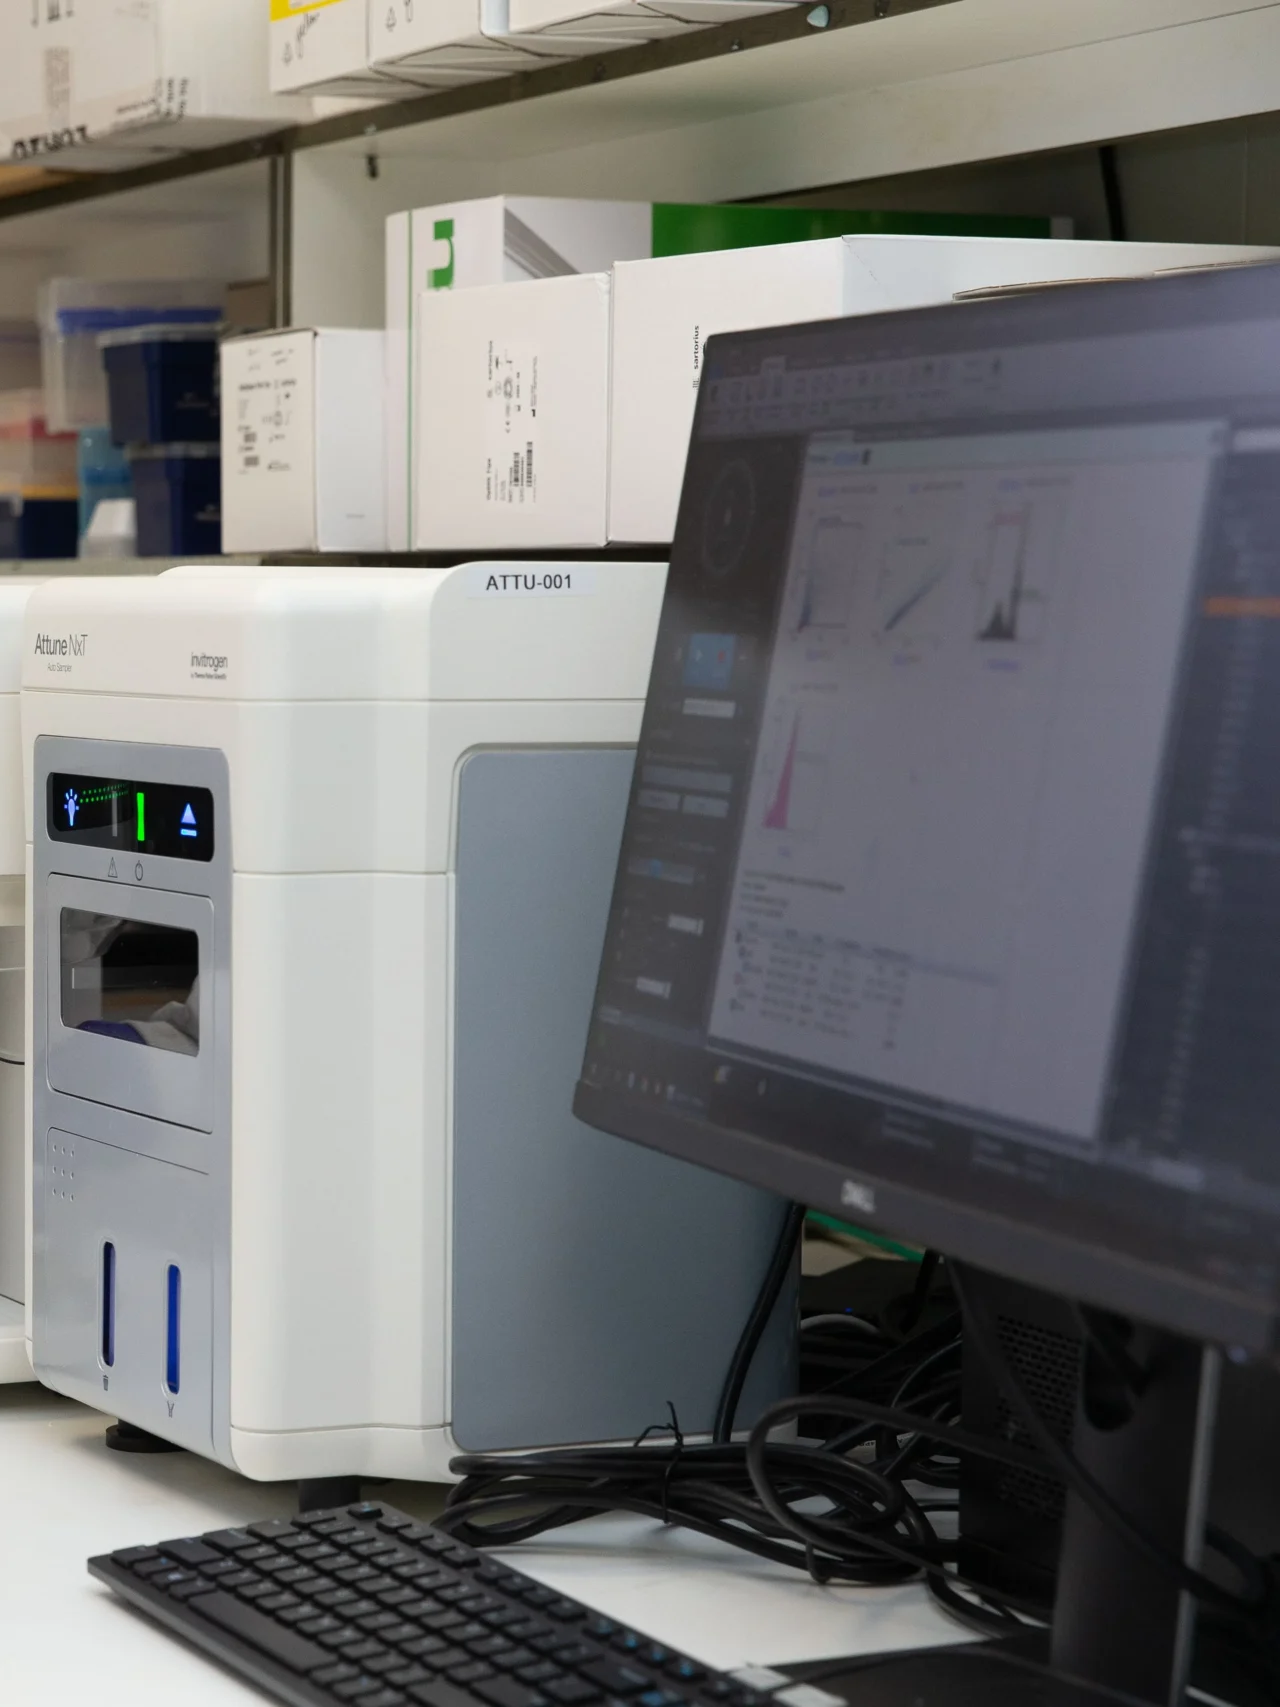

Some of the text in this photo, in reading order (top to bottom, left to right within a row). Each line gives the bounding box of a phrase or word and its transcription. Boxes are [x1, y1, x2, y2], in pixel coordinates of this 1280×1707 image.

[486, 574, 572, 591] ATTU-001
[34, 632, 88, 656] Attune NxT
[191, 652, 228, 672] invitrogen
